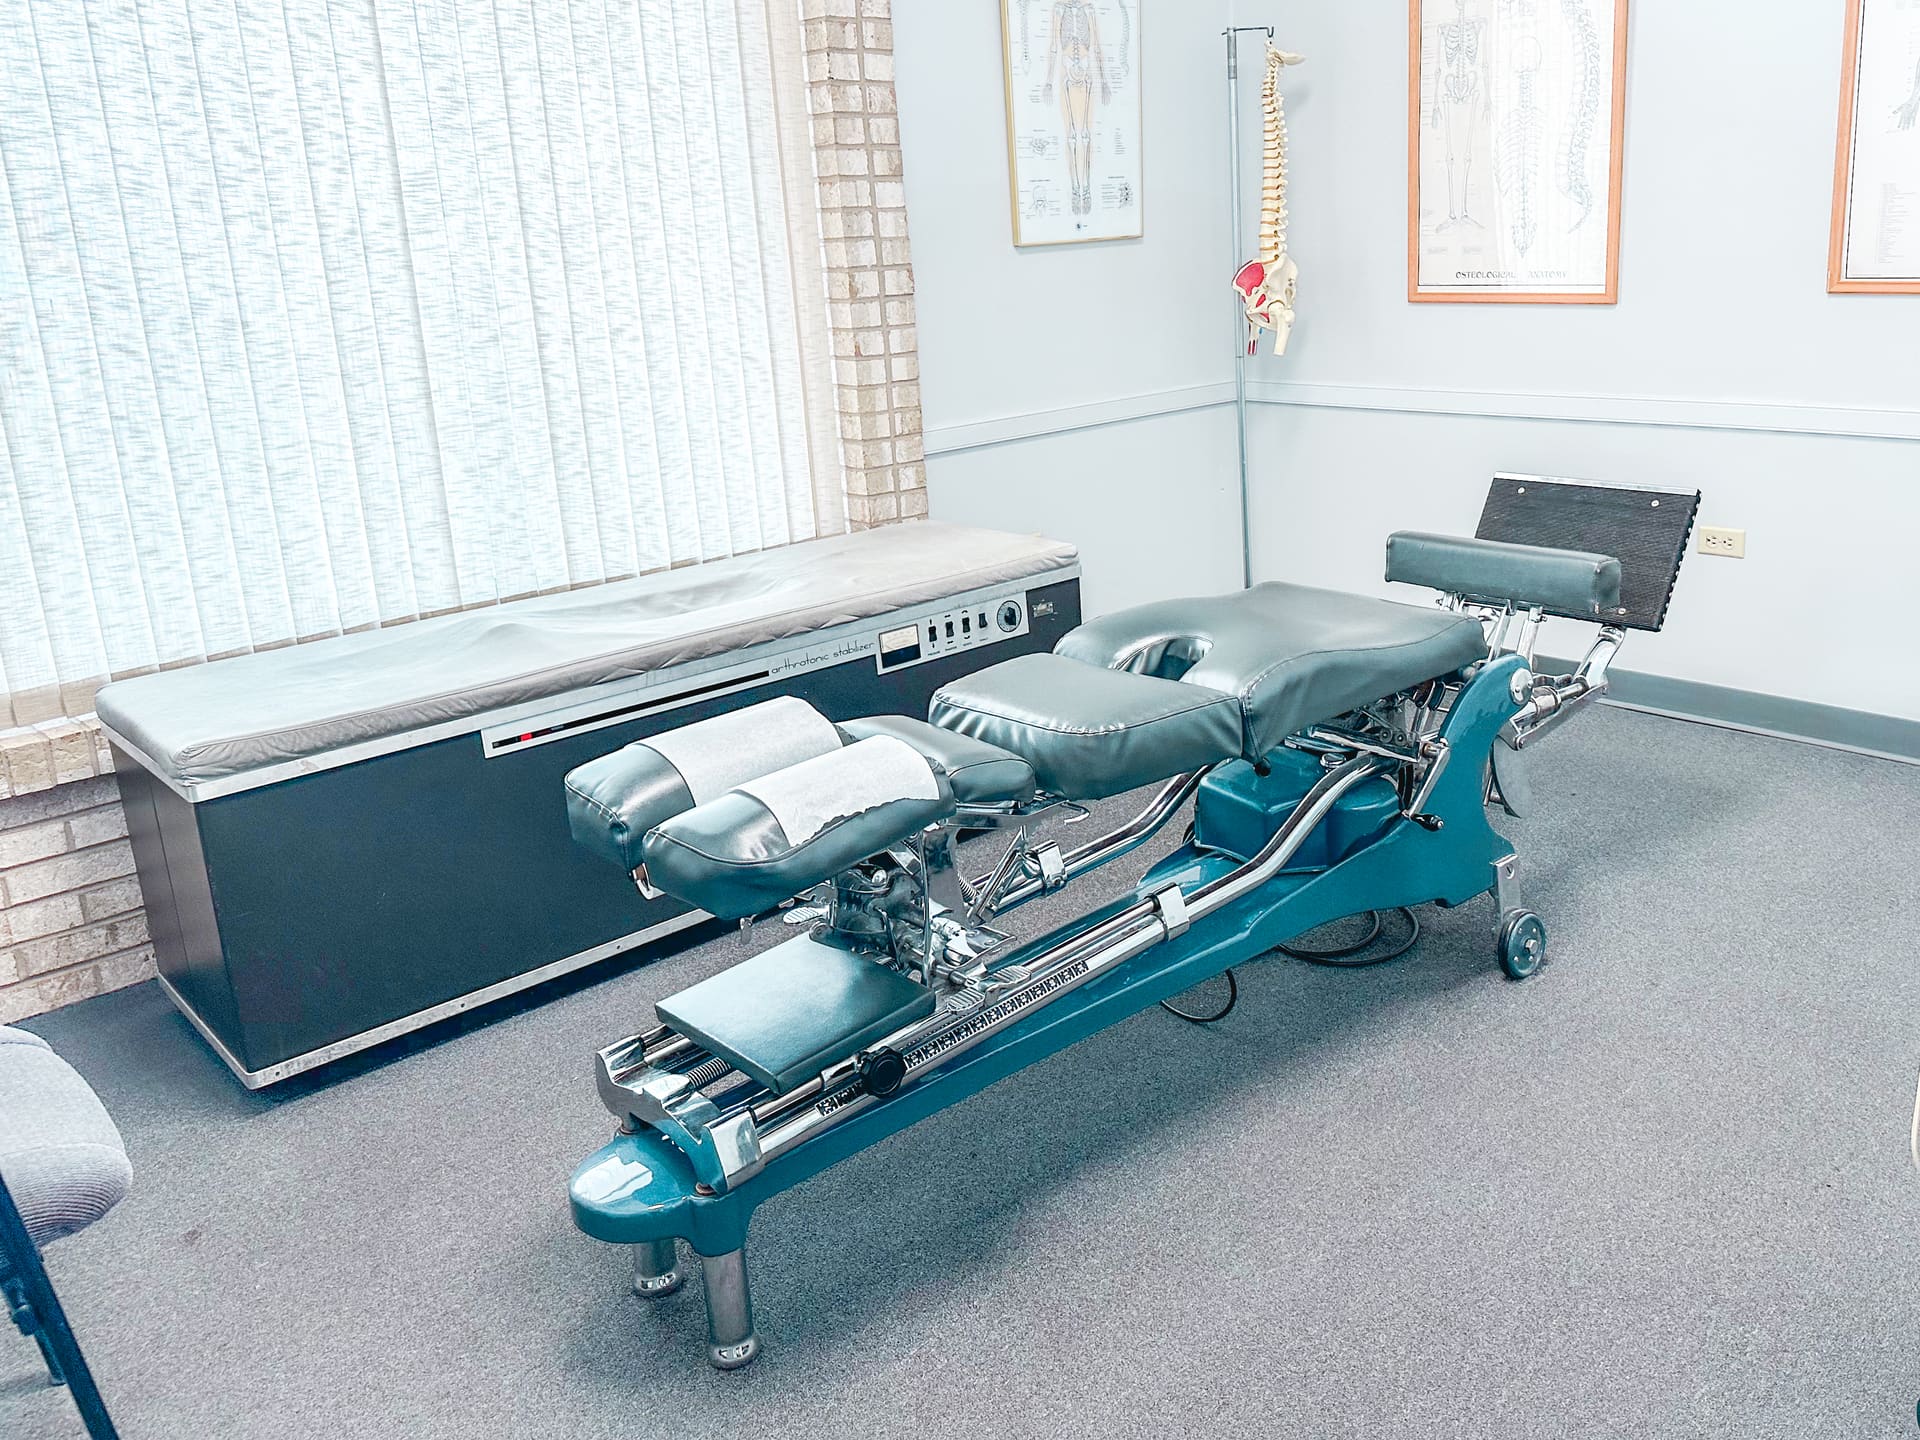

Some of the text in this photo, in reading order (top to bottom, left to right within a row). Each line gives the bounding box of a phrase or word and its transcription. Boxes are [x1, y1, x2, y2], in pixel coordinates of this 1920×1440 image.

[1455, 271, 1517, 279] OSTEOLOGICAL
[771, 639, 875, 674] arthrotonic stabilizer
